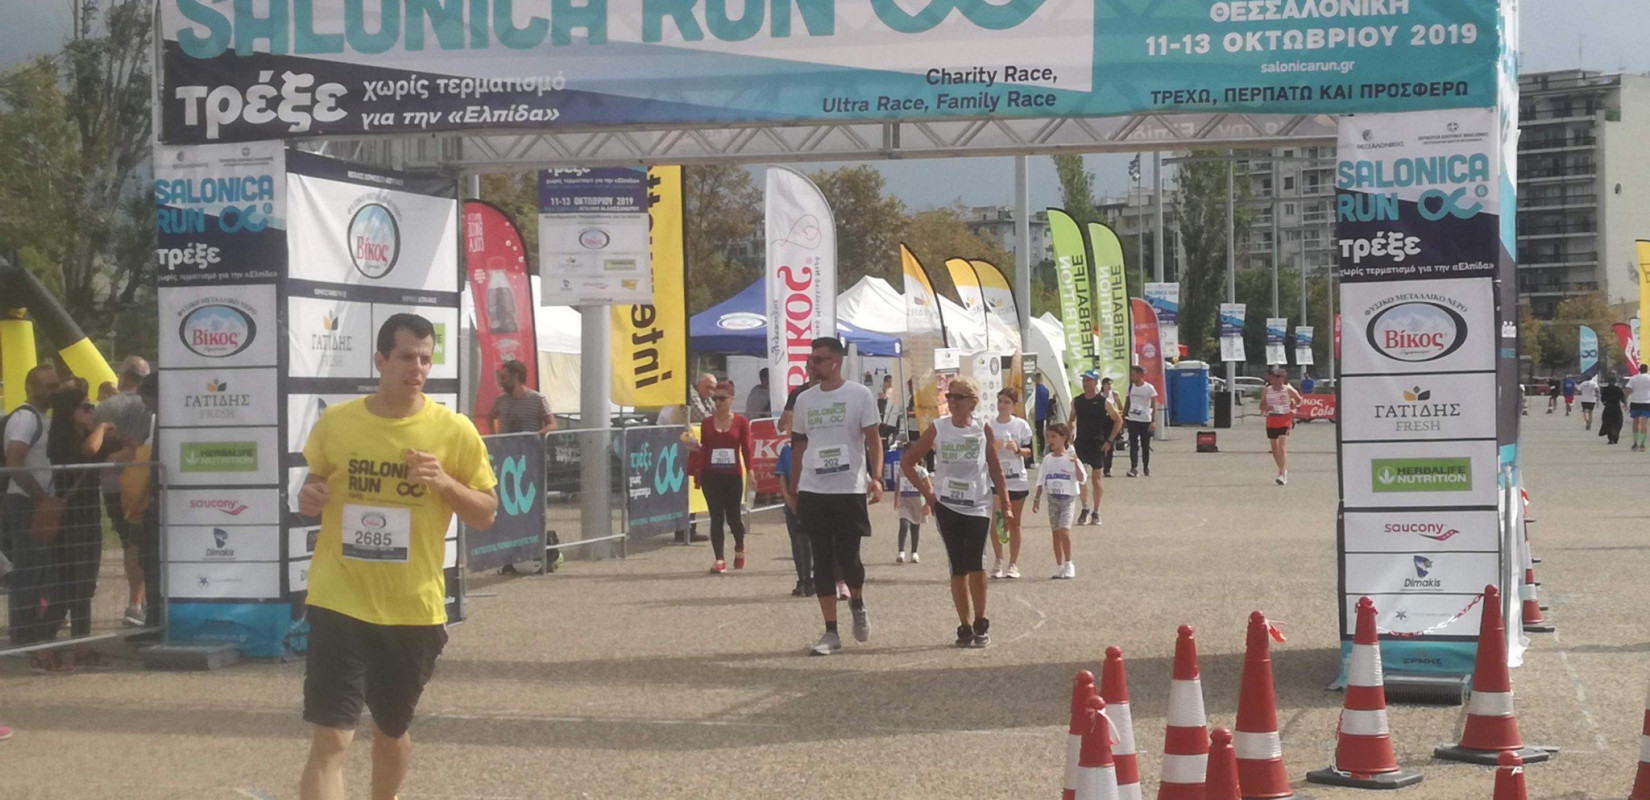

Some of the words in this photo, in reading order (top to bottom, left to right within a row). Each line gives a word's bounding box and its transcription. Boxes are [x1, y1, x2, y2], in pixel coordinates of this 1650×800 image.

[1210, 0, 1409, 22] ΘΕΣΣΑΛΟΝΙΚΗ
[176, 0, 607, 59] SALONICA
[1146, 35, 1210, 56] 11-13
[1223, 26, 1398, 53] ΟΚΤΩΒΡΙΟΥ
[1411, 23, 1478, 46] 2019
[926, 67, 997, 87] Charity
[1004, 66, 1057, 84] Race,
[1261, 59, 1355, 74] salonicarun.gr
[362, 74, 429, 99] χωρίς
[437, 70, 566, 98] τερματισμό
[1151, 89, 1217, 106] ΤΡΕΧΩ,
[1224, 85, 1312, 103] ΠΕΡΠΑΤΩ
[1320, 84, 1352, 100] ΚΑΙ
[1360, 81, 1468, 98] ΠΡΟΣΦΕΡΩ
[175, 70, 348, 139] τρέξε
[822, 97, 870, 114] Ultra
[876, 96, 930, 113] Race,
[937, 93, 1000, 112] Family
[1007, 91, 1056, 108] Race
[361, 111, 394, 131] για
[403, 110, 440, 129] την
[448, 103, 560, 125] «Ελπίδα»
[1338, 153, 1489, 188] SALONICA
[154, 175, 274, 205] SALONICA
[551, 197, 571, 205] 11-13
[1337, 193, 1399, 222] RUN
[156, 207, 205, 234] RUN
[157, 243, 221, 270] τρέξε
[356, 236, 388, 262] Βίκος
[1339, 231, 1421, 263] τρέξε
[1366, 265, 1416, 275] τερματισμό
[1418, 266, 1432, 274] για
[1435, 265, 1450, 273] την
[1364, 296, 1395, 315] ΦΥΣΙΚΟ
[192, 328, 239, 348] Βίκος
[1385, 329, 1444, 350] Βίκος
[185, 394, 250, 408] ΓΑΤΙΔΗΣ
[1310, 405, 1335, 417] Cola
[1375, 403, 1460, 418] ΓΑΤΙΔΗΣ
[1396, 421, 1440, 432] FRESH
[348, 458, 408, 479] SALONI
[824, 458, 839, 467] 202
[1397, 465, 1466, 474] HERBALIFE
[348, 476, 381, 493] RUN
[1397, 474, 1466, 483] NUTRITION
[190, 499, 236, 509] saucony
[950, 490, 964, 499] 221
[355, 530, 392, 546] 2685
[1384, 522, 1444, 534] saucony
[1404, 578, 1441, 587] Dimakis
